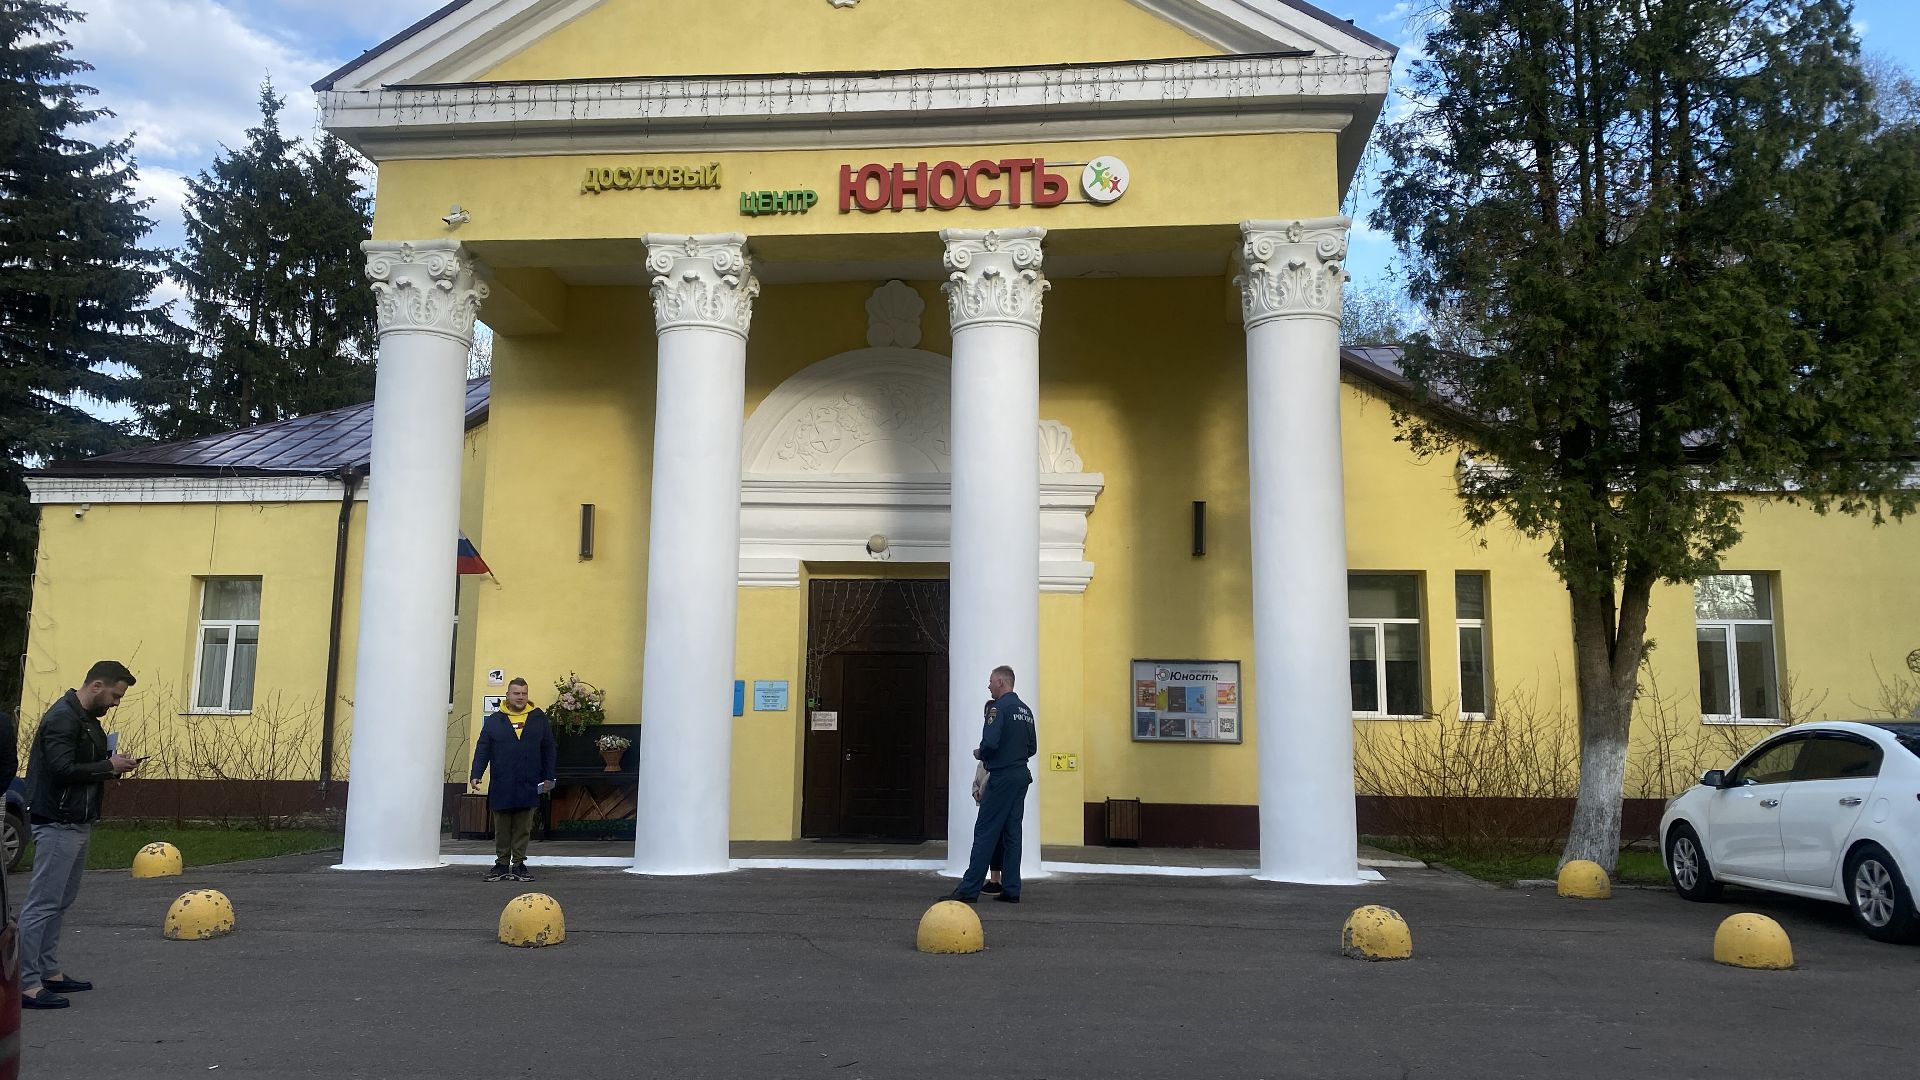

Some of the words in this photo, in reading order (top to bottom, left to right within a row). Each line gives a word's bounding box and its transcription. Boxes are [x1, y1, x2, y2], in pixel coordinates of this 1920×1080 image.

[582, 162, 721, 193] ДОСУГОВЫЙ
[839, 158, 1069, 212] ЮНОСТЬ
[740, 190, 818, 216] ЦЕНТР
[1170, 671, 1219, 681] Юность
